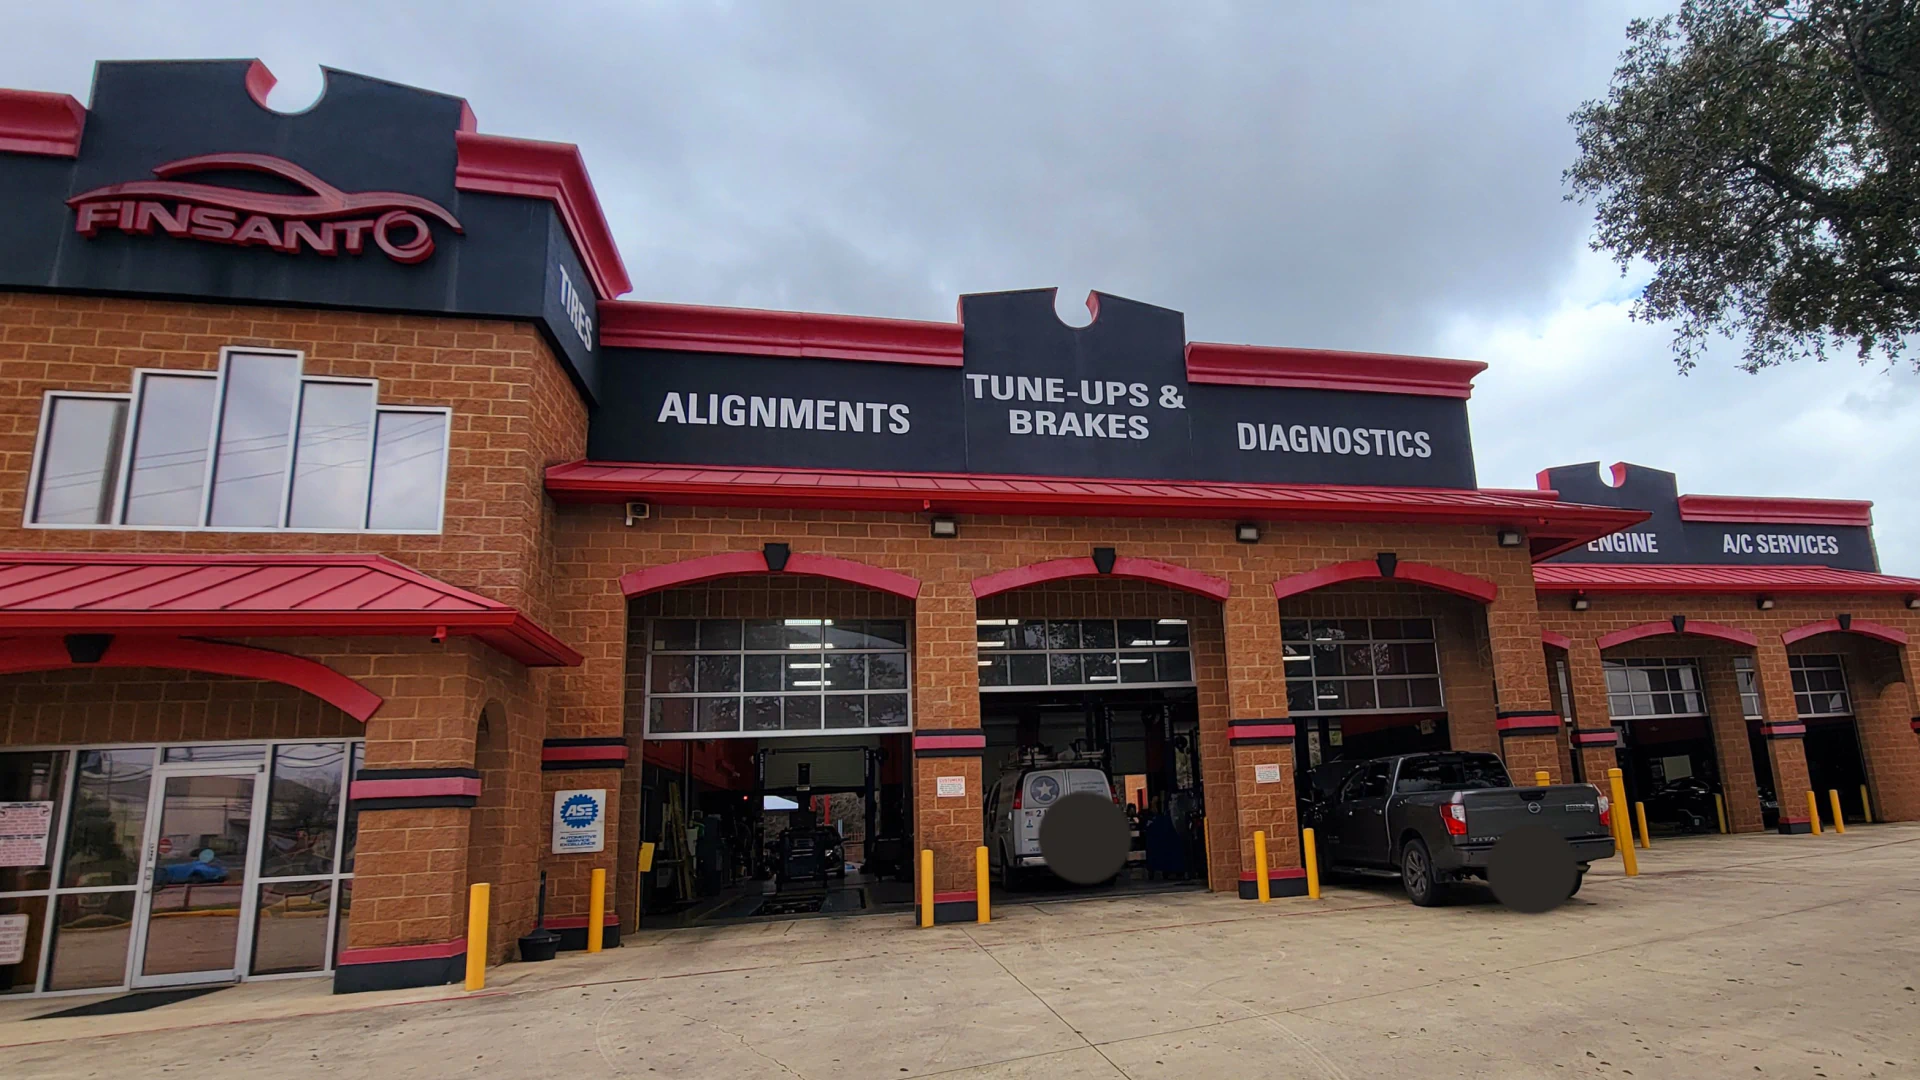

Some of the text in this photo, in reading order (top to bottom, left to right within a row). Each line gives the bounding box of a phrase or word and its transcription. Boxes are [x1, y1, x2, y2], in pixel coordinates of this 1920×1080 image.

[75, 200, 434, 264] FINSANTO
[559, 264, 593, 352] TIRES
[966, 373, 1186, 409] TUNE-UPS &
[657, 391, 911, 435] ALIGNMENTS
[1008, 409, 1150, 440] BRAKES
[1236, 422, 1433, 459] DIAGNOSTICS
[1587, 532, 1659, 553] ENGINE
[1723, 533, 1839, 555] A/C SERVICES
[564, 803, 594, 817] ASE
